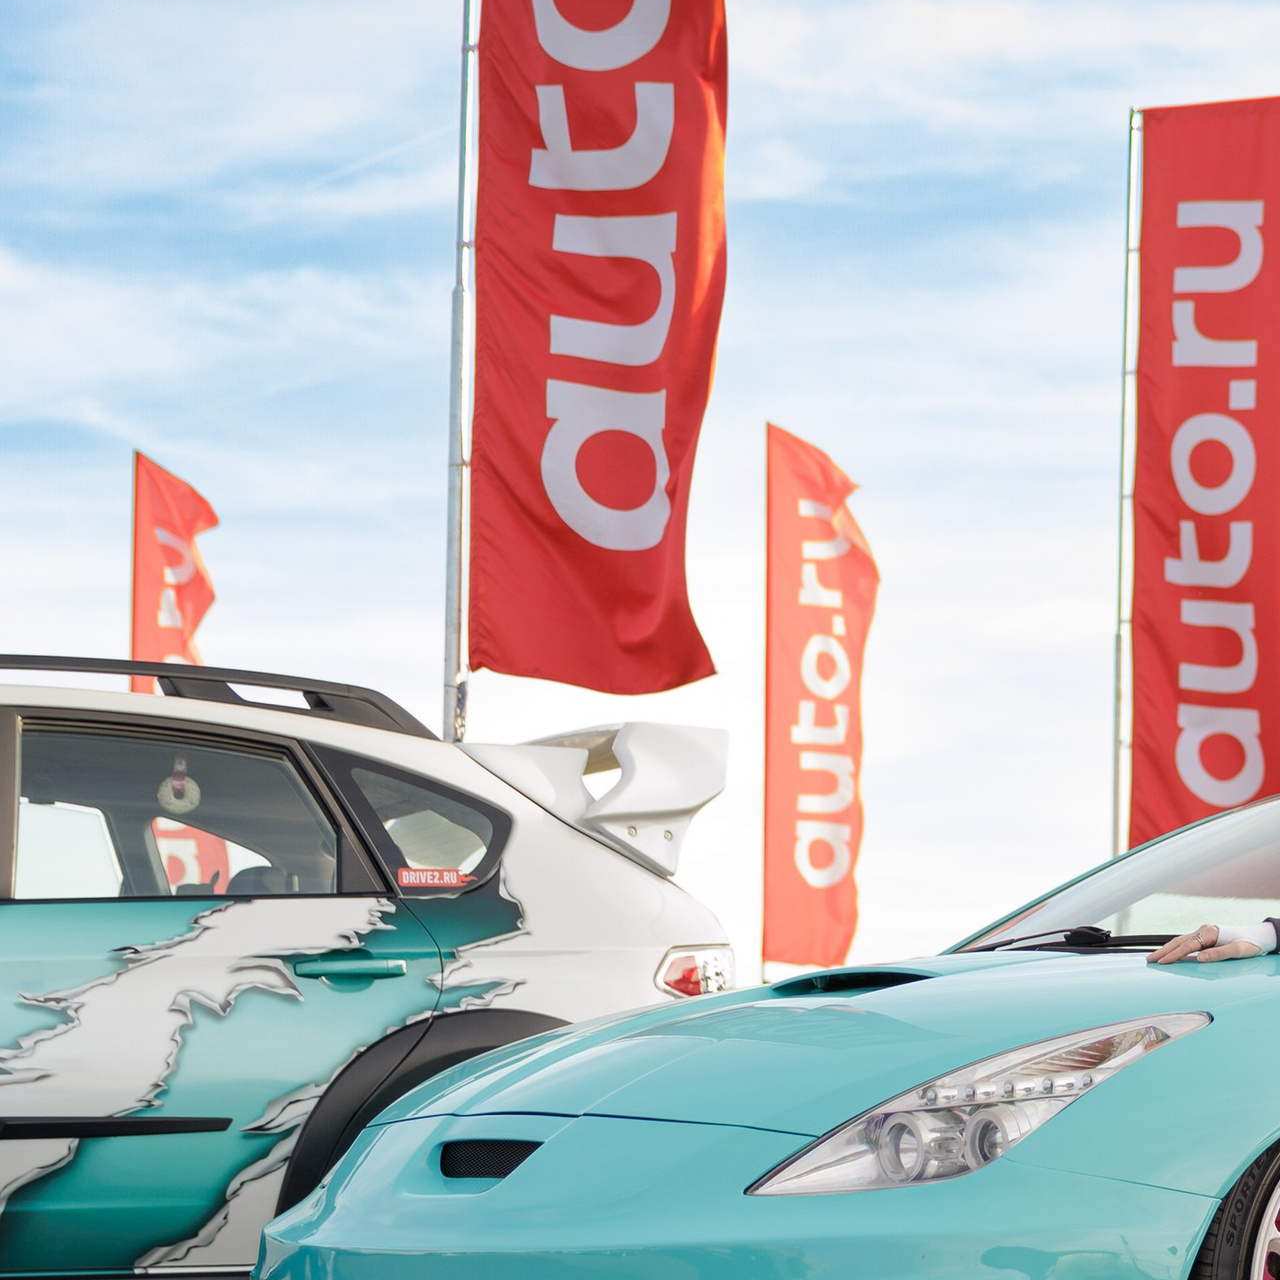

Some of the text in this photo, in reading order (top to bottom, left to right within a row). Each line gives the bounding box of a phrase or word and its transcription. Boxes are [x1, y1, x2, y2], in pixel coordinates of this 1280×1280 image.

[790, 498, 856, 889] auto.ru
[1164, 199, 1266, 808] auto.ru
[402, 870, 458, 884] DRIVE2.RU
